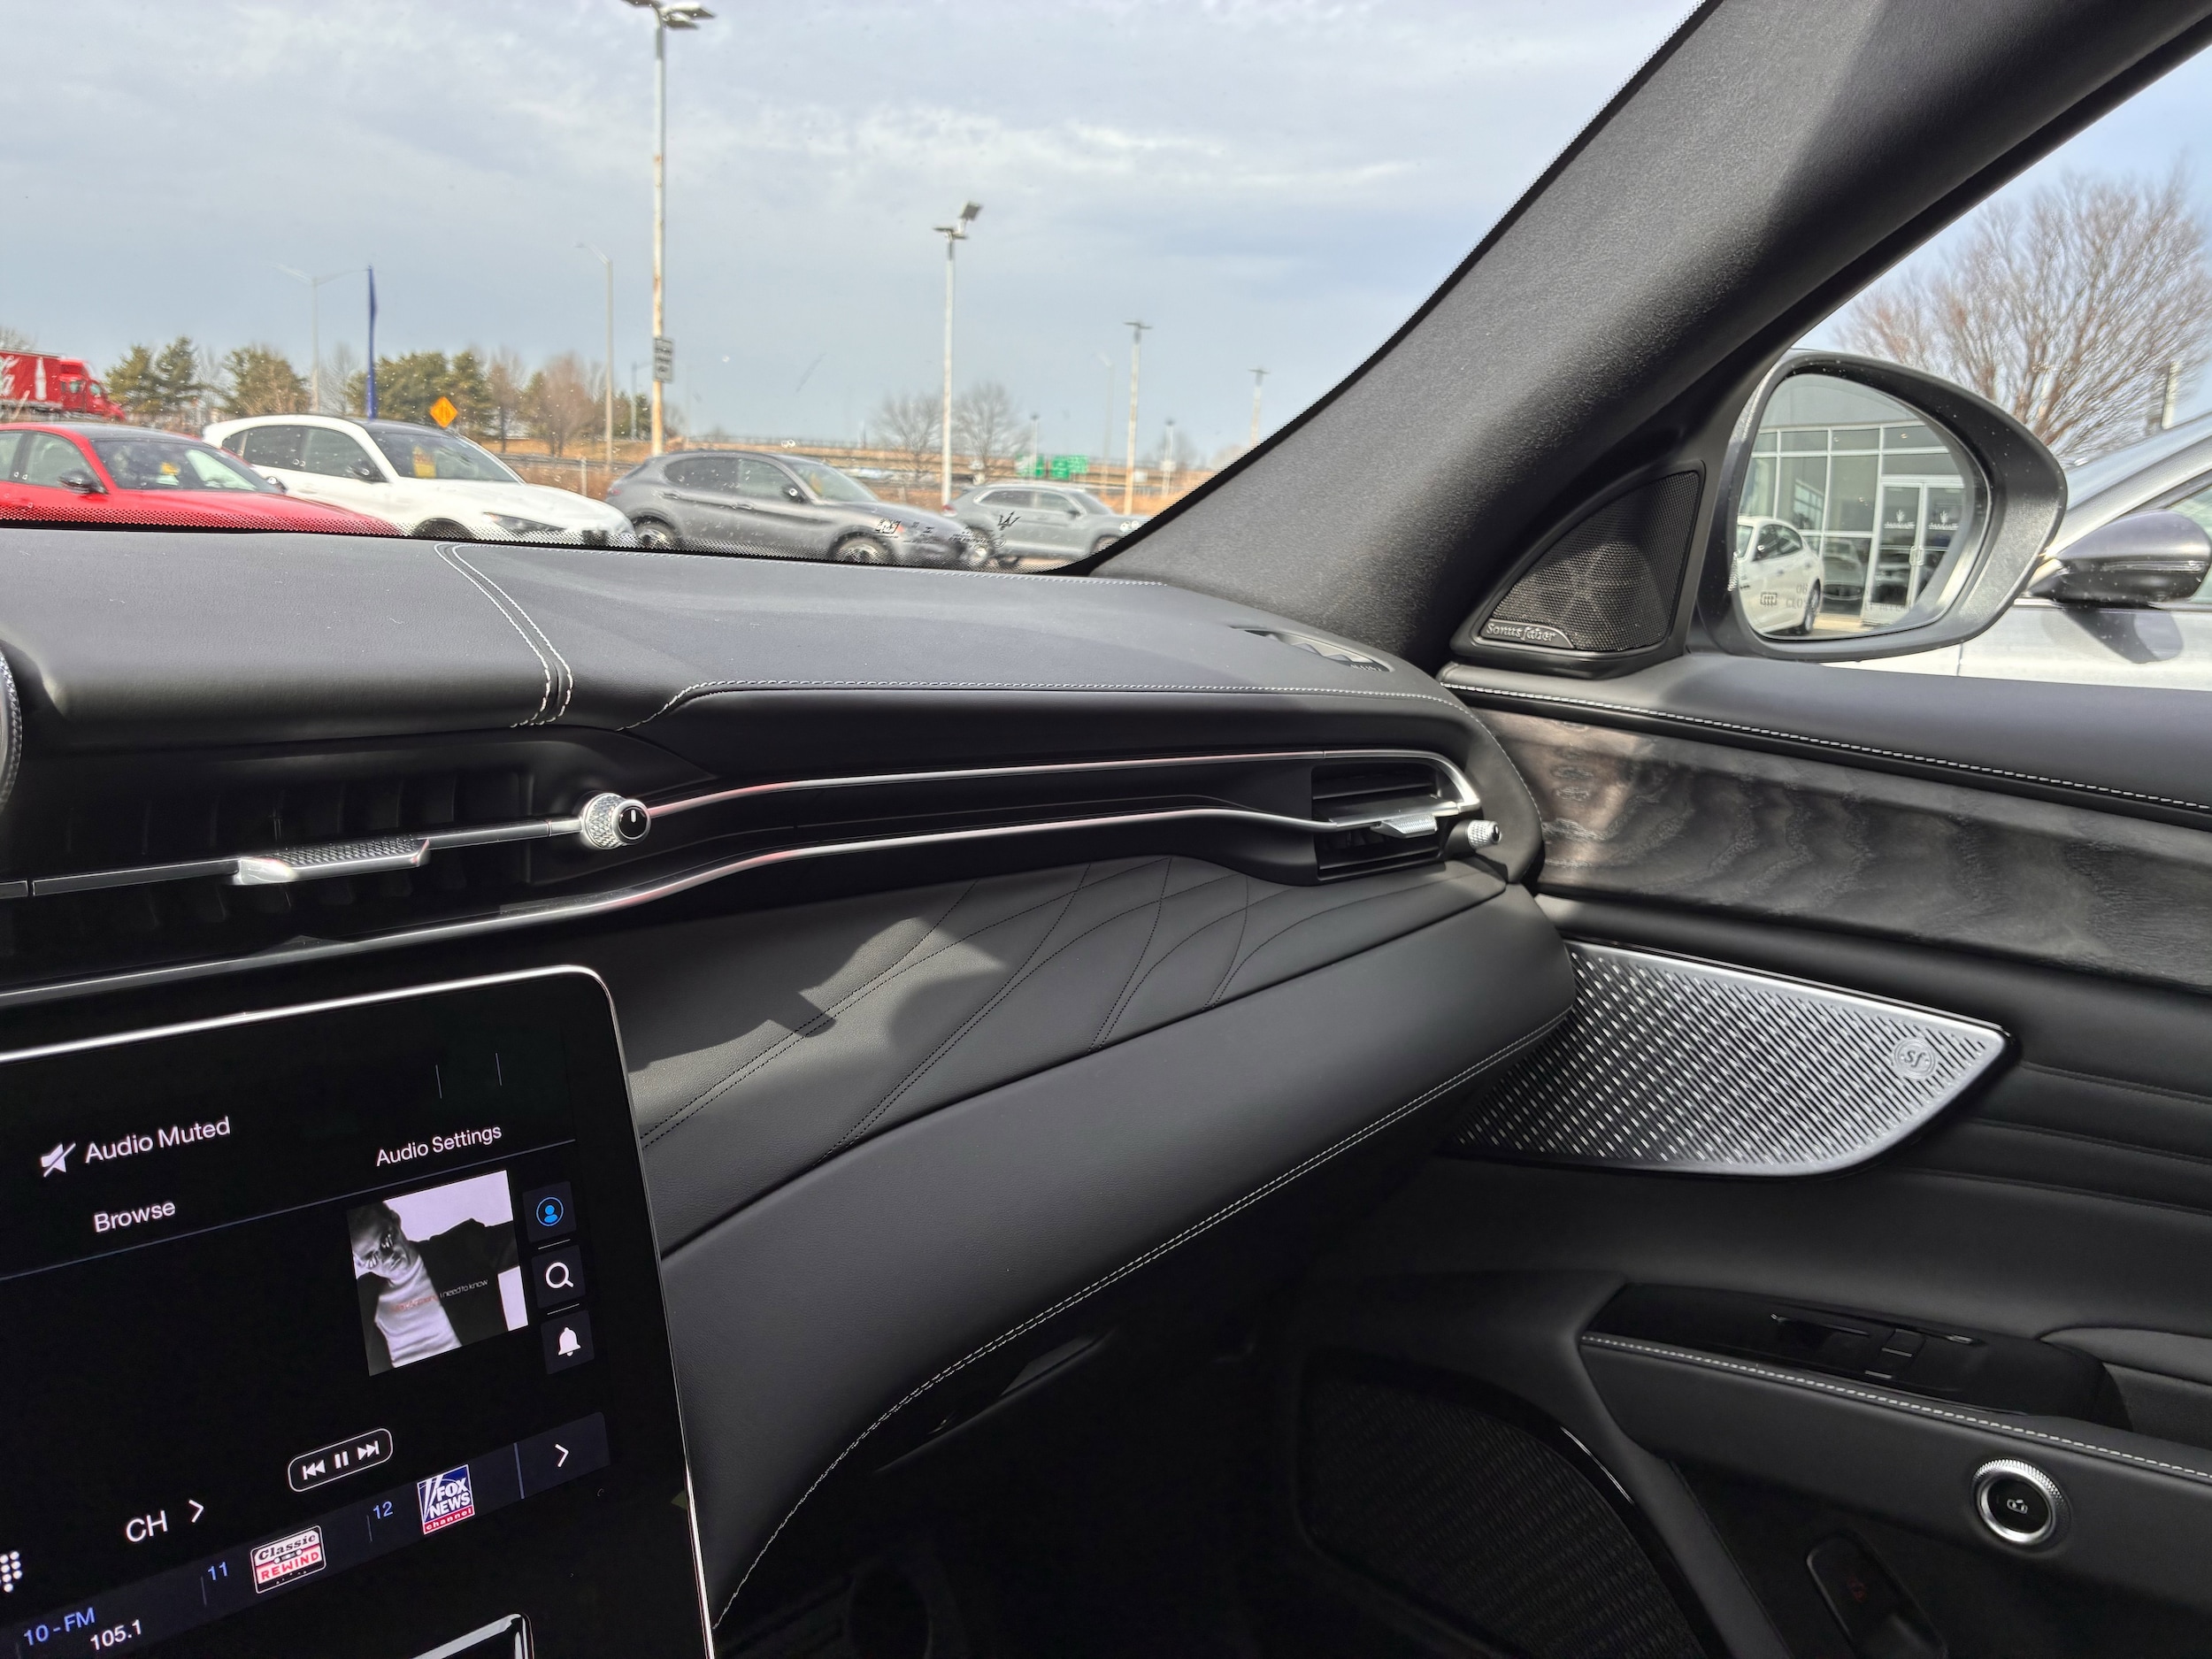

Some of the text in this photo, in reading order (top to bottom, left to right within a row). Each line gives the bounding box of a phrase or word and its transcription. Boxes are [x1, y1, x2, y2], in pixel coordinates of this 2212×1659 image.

[85, 1116, 231, 1164] Audio Muted
[376, 1126, 502, 1167] Audio Settings
[94, 1201, 176, 1233] Browse
[469, 1279, 488, 1290] know
[436, 1477, 469, 1502] FOX
[373, 1501, 394, 1520] 12
[428, 1492, 471, 1519] NEWS
[127, 1509, 168, 1542] CH
[258, 1533, 316, 1561] Classic
[207, 1561, 229, 1581] 11
[261, 1552, 319, 1580] REWIND
[90, 1619, 142, 1650] 105.1
